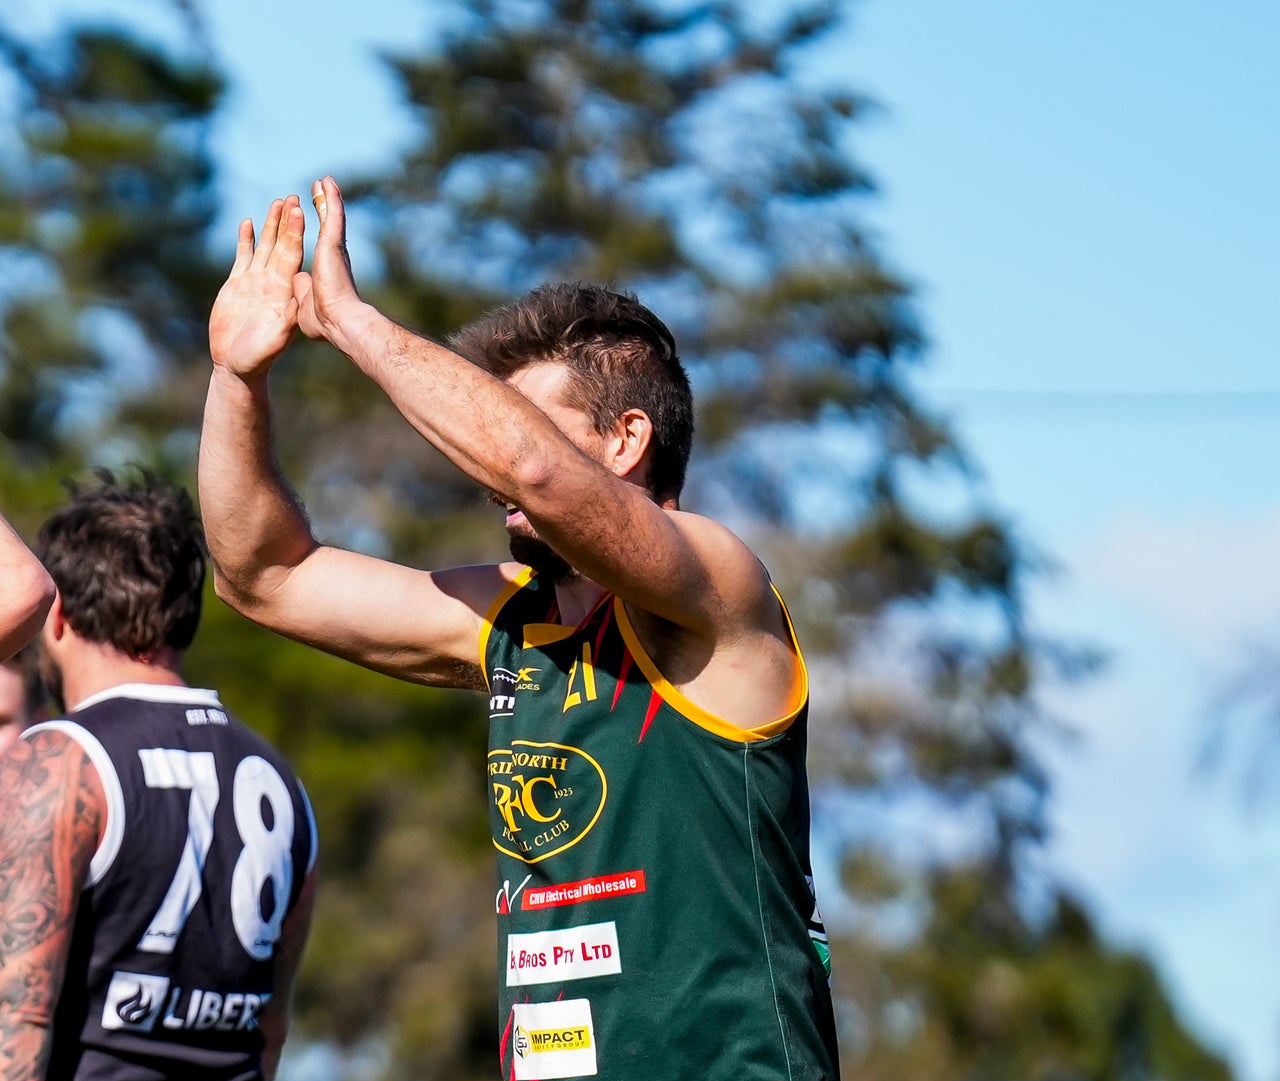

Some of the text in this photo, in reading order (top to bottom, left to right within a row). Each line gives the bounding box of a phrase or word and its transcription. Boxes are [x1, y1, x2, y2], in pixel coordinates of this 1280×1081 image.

[534, 819, 570, 847] CLUB
[137, 748, 294, 961] 78
[532, 1030, 585, 1045] IMPACT
